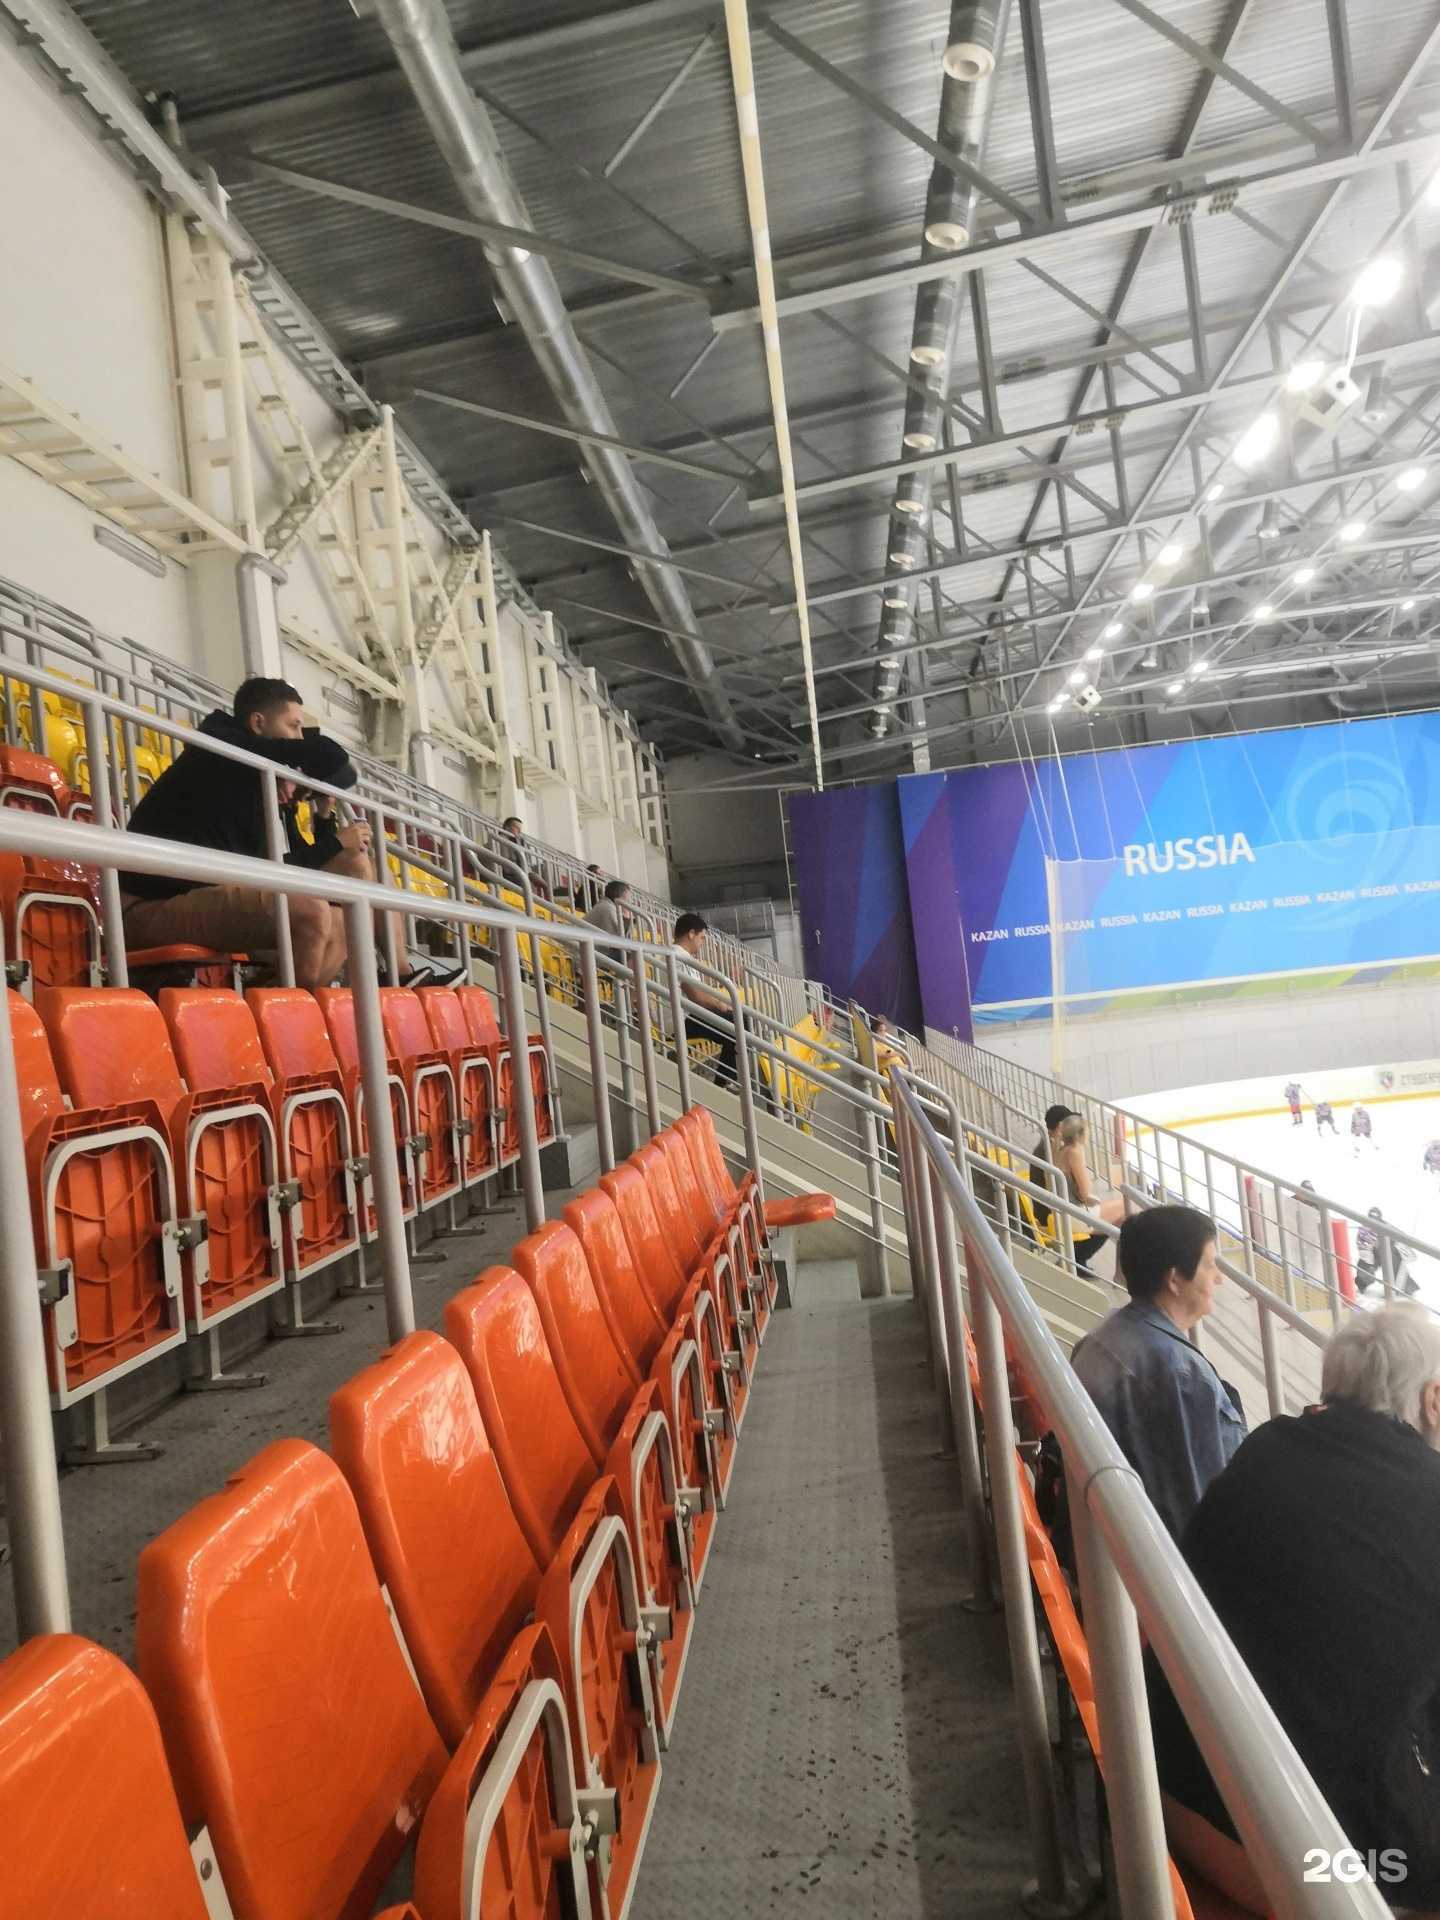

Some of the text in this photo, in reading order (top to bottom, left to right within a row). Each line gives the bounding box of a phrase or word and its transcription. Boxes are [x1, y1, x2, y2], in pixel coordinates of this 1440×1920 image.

[1123, 832, 1257, 877] RUSSIA
[971, 928, 1009, 942] KAZAN
[1014, 923, 1052, 938] RUSSIA
[1100, 914, 1137, 928] RUSSIA
[1143, 909, 1181, 923] KAZAN
[1186, 904, 1224, 918] RUSSIA
[1229, 899, 1267, 913] KAZAN
[1273, 894, 1312, 908] RUSSIA
[1316, 889, 1355, 903] KAZAN
